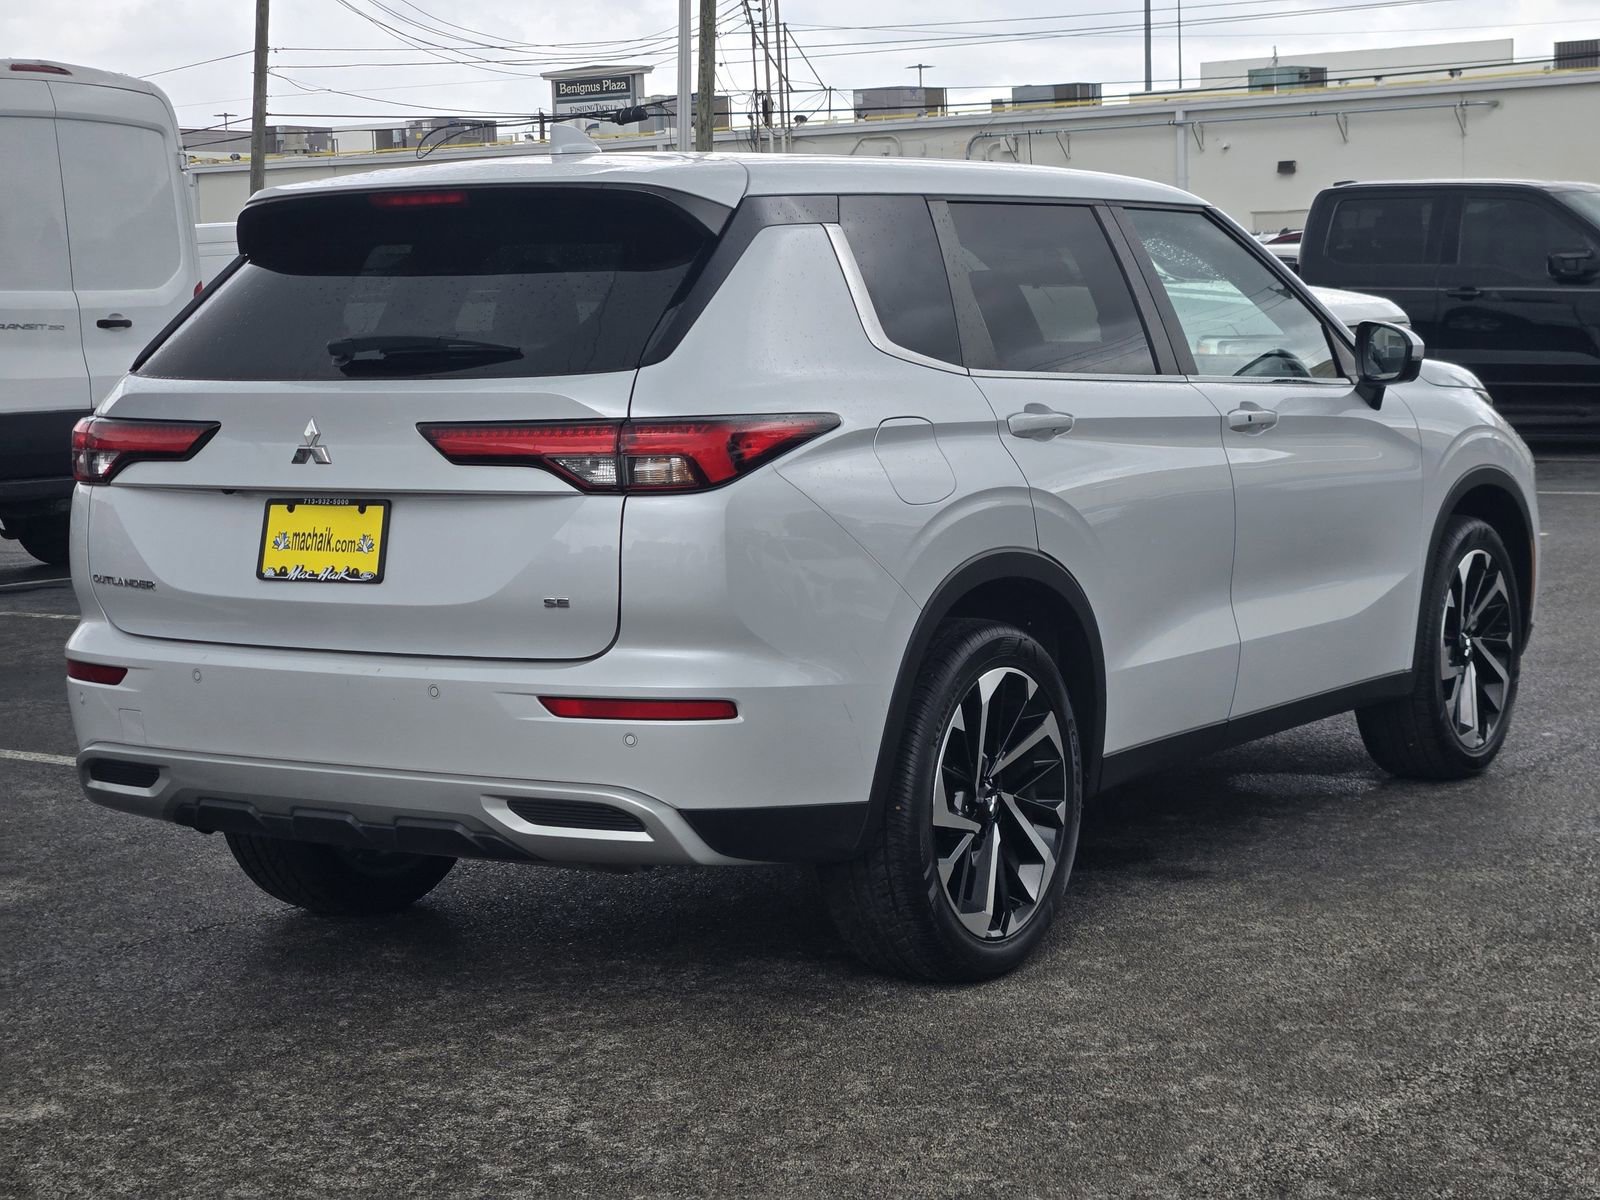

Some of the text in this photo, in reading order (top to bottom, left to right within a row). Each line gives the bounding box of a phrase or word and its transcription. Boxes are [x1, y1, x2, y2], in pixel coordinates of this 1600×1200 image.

[559, 79, 627, 95] Benignus Plaza
[290, 526, 356, 553] machaik.com
[288, 564, 317, 581] Mac
[317, 565, 350, 581] Haik
[93, 574, 157, 592] OUTLANDER
[543, 597, 570, 609] SE
